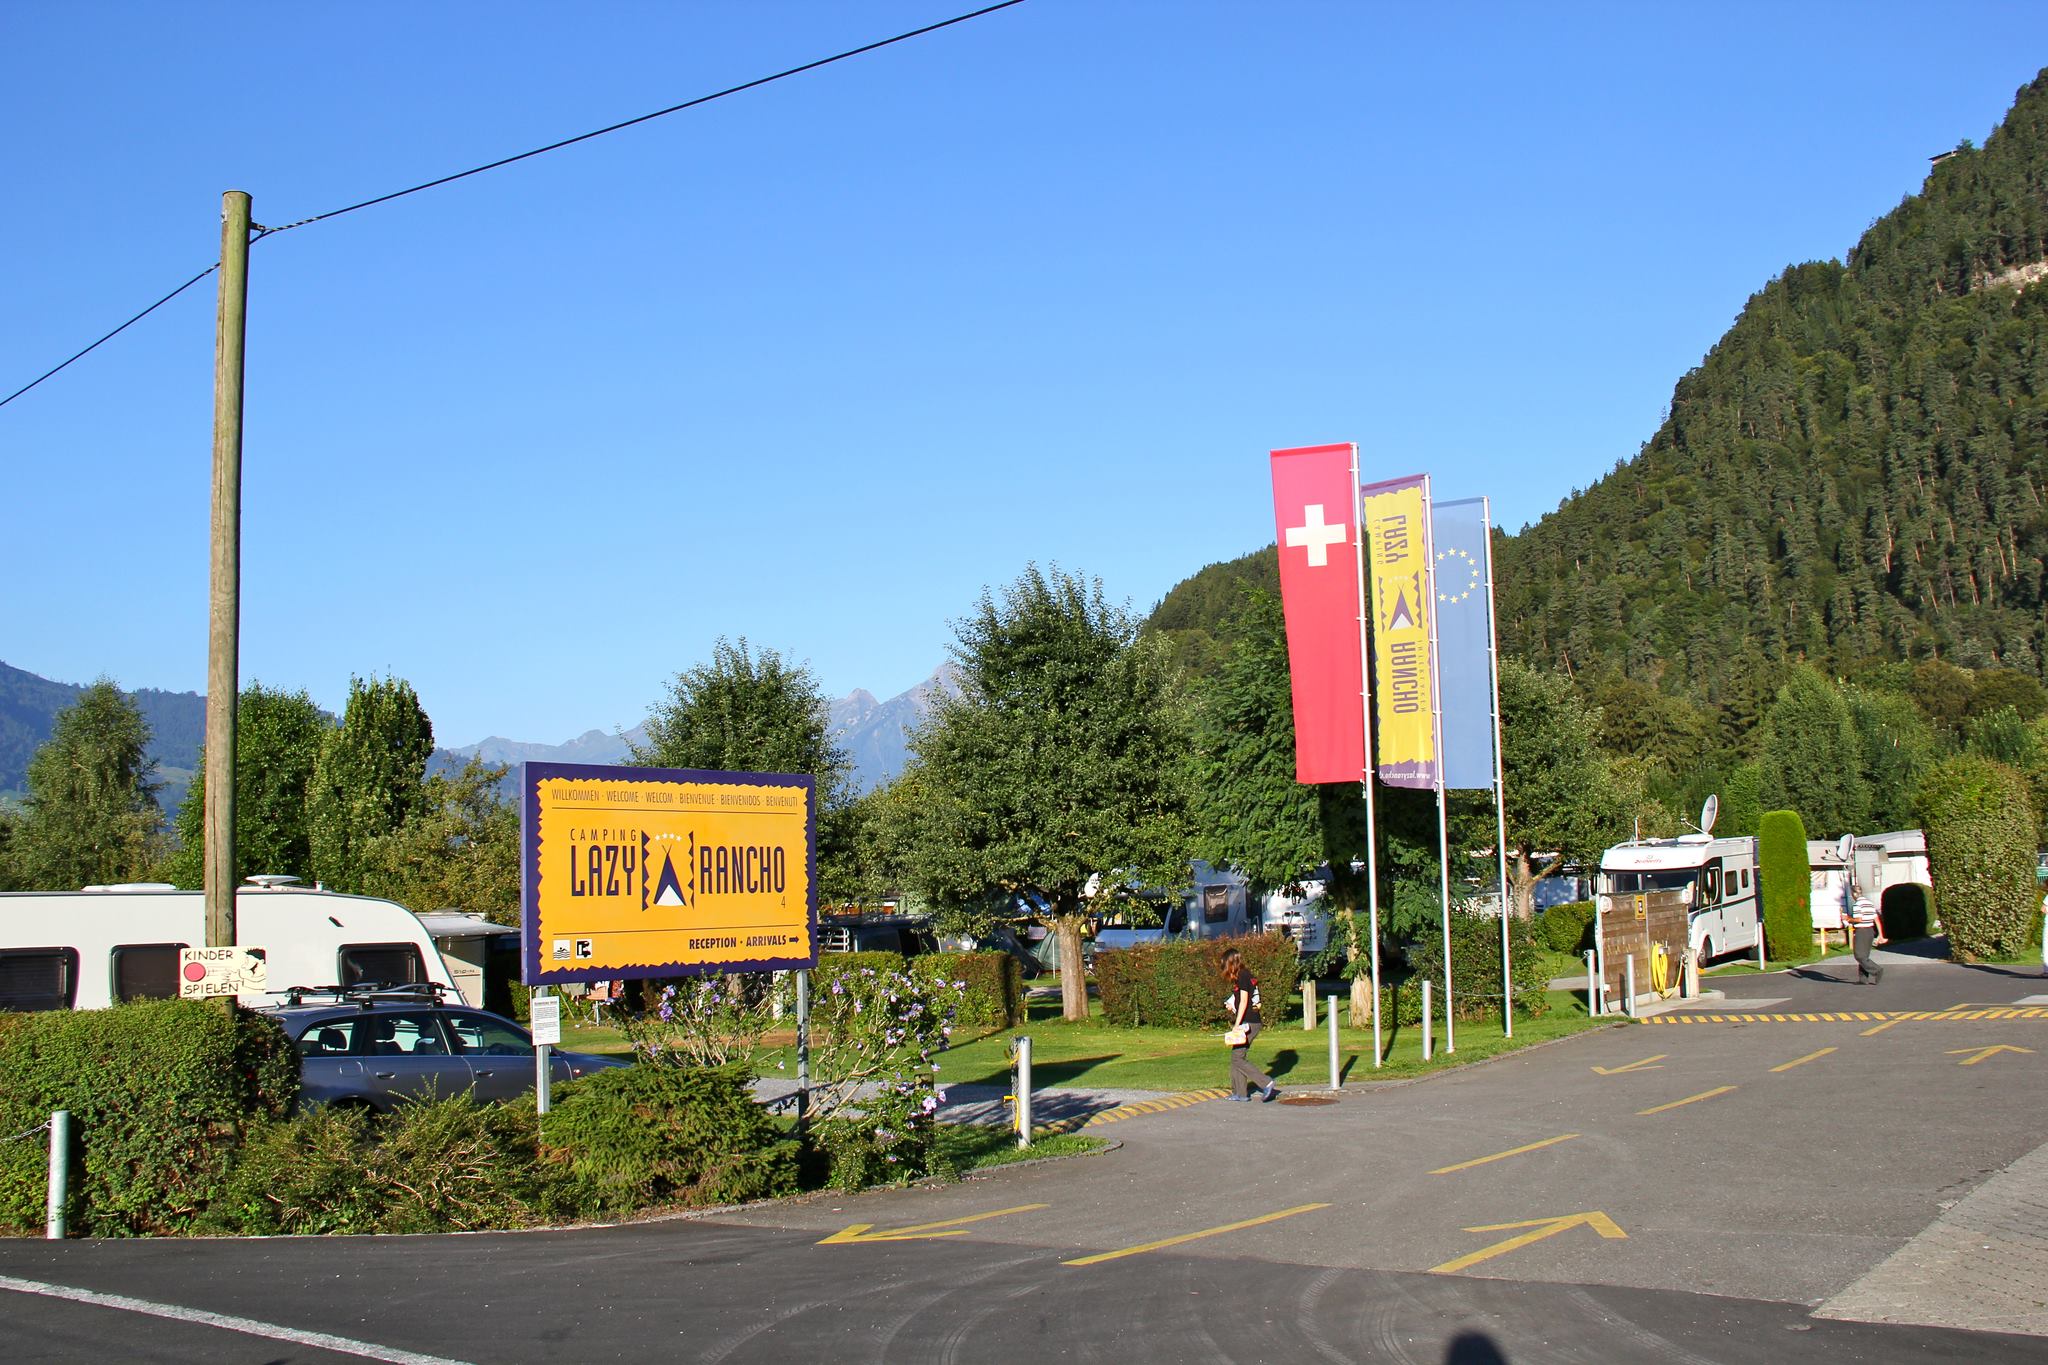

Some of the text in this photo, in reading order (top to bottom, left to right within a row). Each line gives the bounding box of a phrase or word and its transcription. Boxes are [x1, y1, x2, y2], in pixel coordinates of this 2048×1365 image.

[552, 789, 798, 807] WILLKOMMEN WELCOME WELCOM BIENVENUE BIENVENIDOS BENVENUTI
[570, 828, 637, 842] CAMPING
[570, 844, 785, 897] LAZY RANCHO
[780, 895, 786, 909] 4
[689, 934, 787, 950] RECEPTION ARRIVALS
[184, 949, 234, 961] KINDER
[183, 982, 239, 995] SPIELEN
